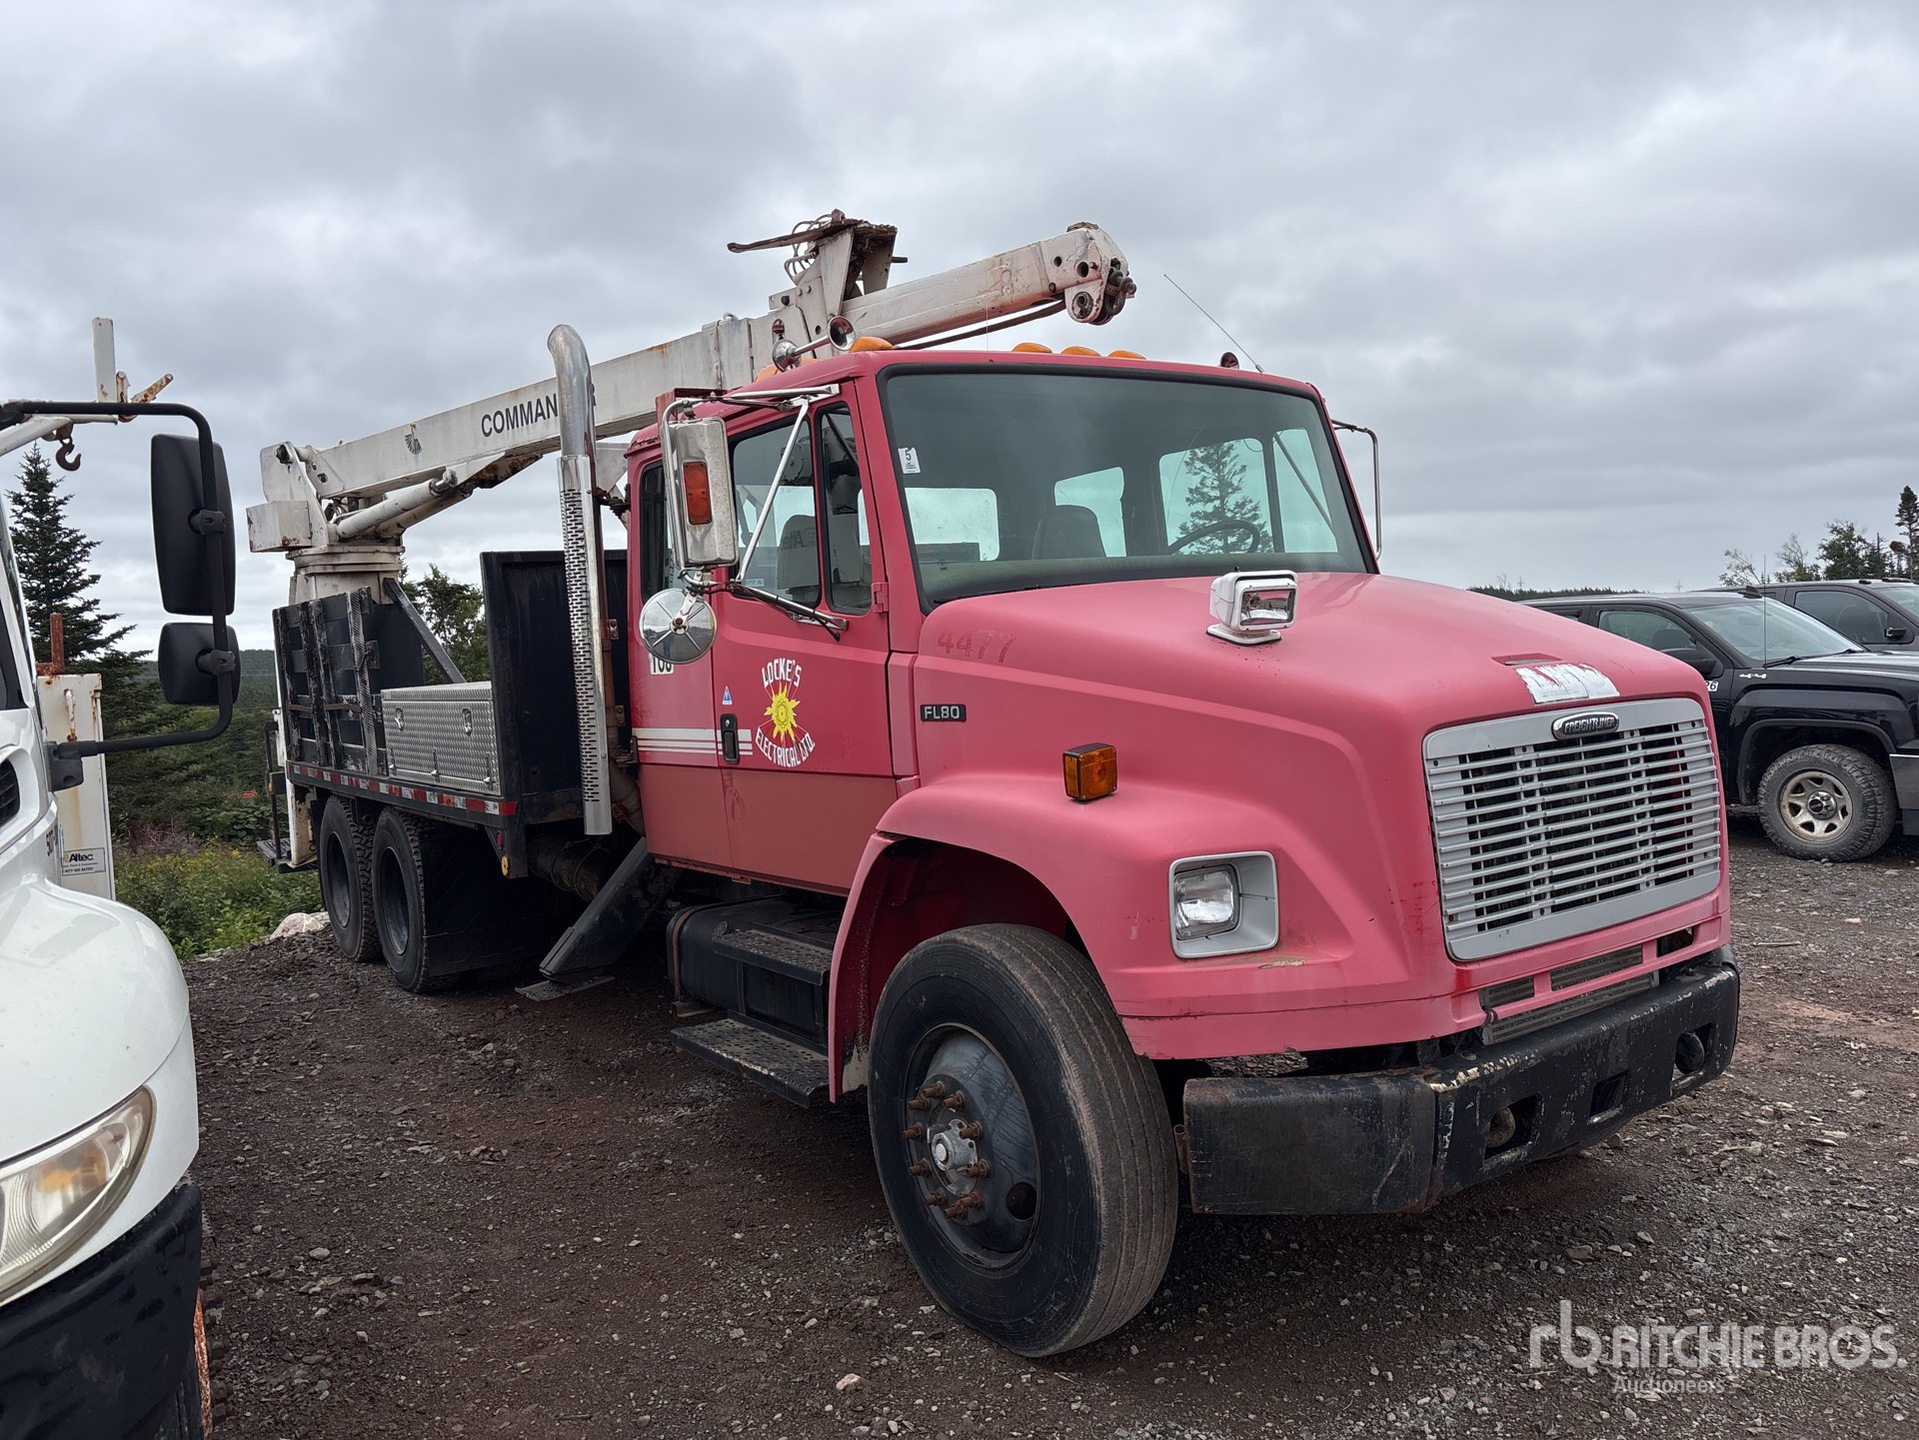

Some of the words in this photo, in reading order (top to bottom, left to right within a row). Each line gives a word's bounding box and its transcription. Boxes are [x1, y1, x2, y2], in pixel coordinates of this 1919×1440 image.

[481, 384, 597, 438] COMMAN
[905, 449, 912, 461] 5
[937, 629, 1016, 663] 4477
[761, 658, 802, 688] LOCKE'S
[924, 706, 960, 719] FL80
[1564, 717, 1615, 733] FREIGHTLINER
[755, 727, 802, 767] ELECTRICAL
[69, 853, 94, 862] Altec
